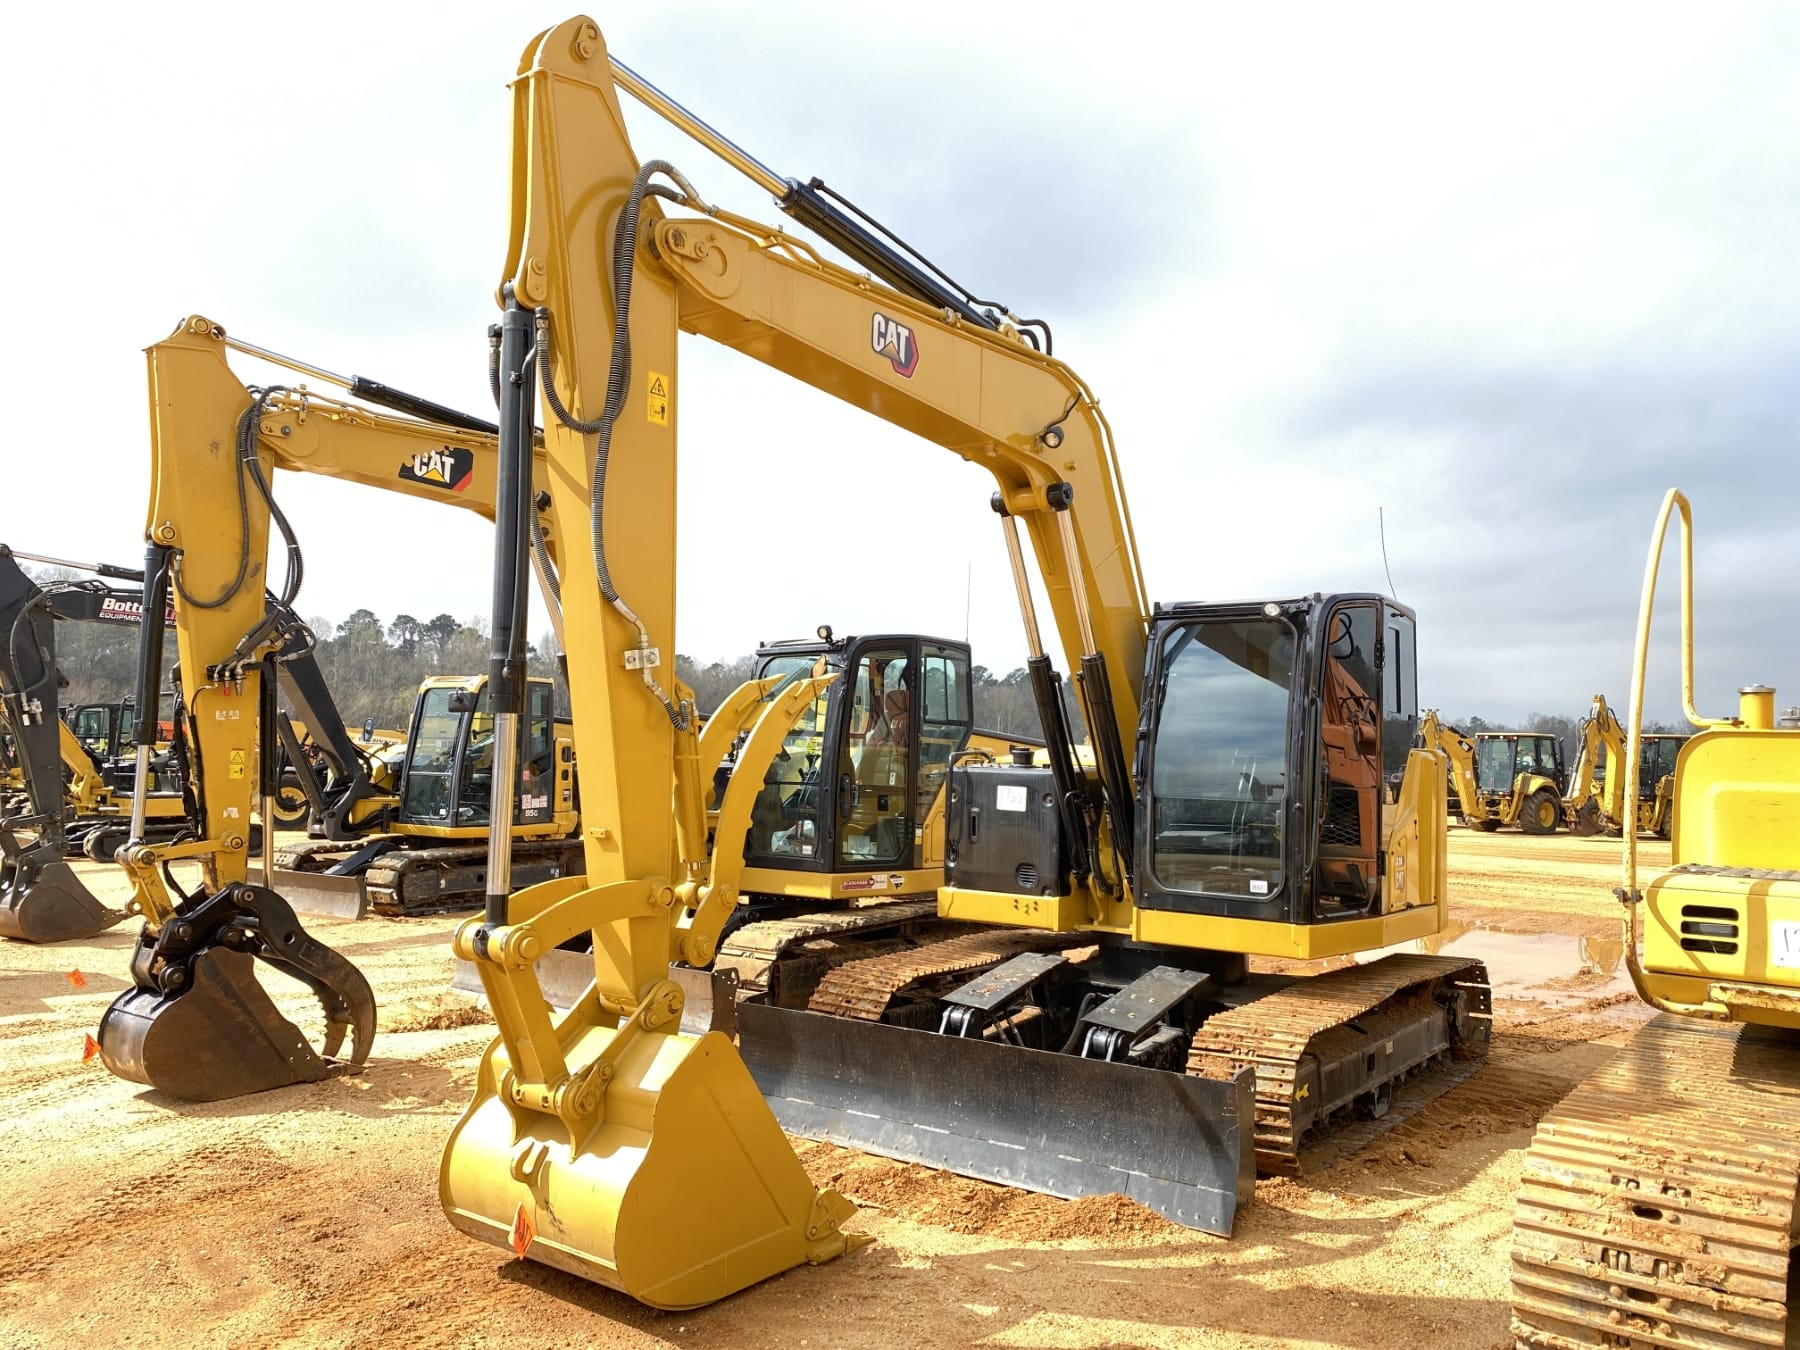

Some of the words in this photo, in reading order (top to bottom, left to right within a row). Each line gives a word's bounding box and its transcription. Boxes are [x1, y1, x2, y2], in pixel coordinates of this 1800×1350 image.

[872, 312, 910, 365] CAT
[413, 449, 455, 484] CAT
[99, 611, 143, 622] EQUIPMEN
